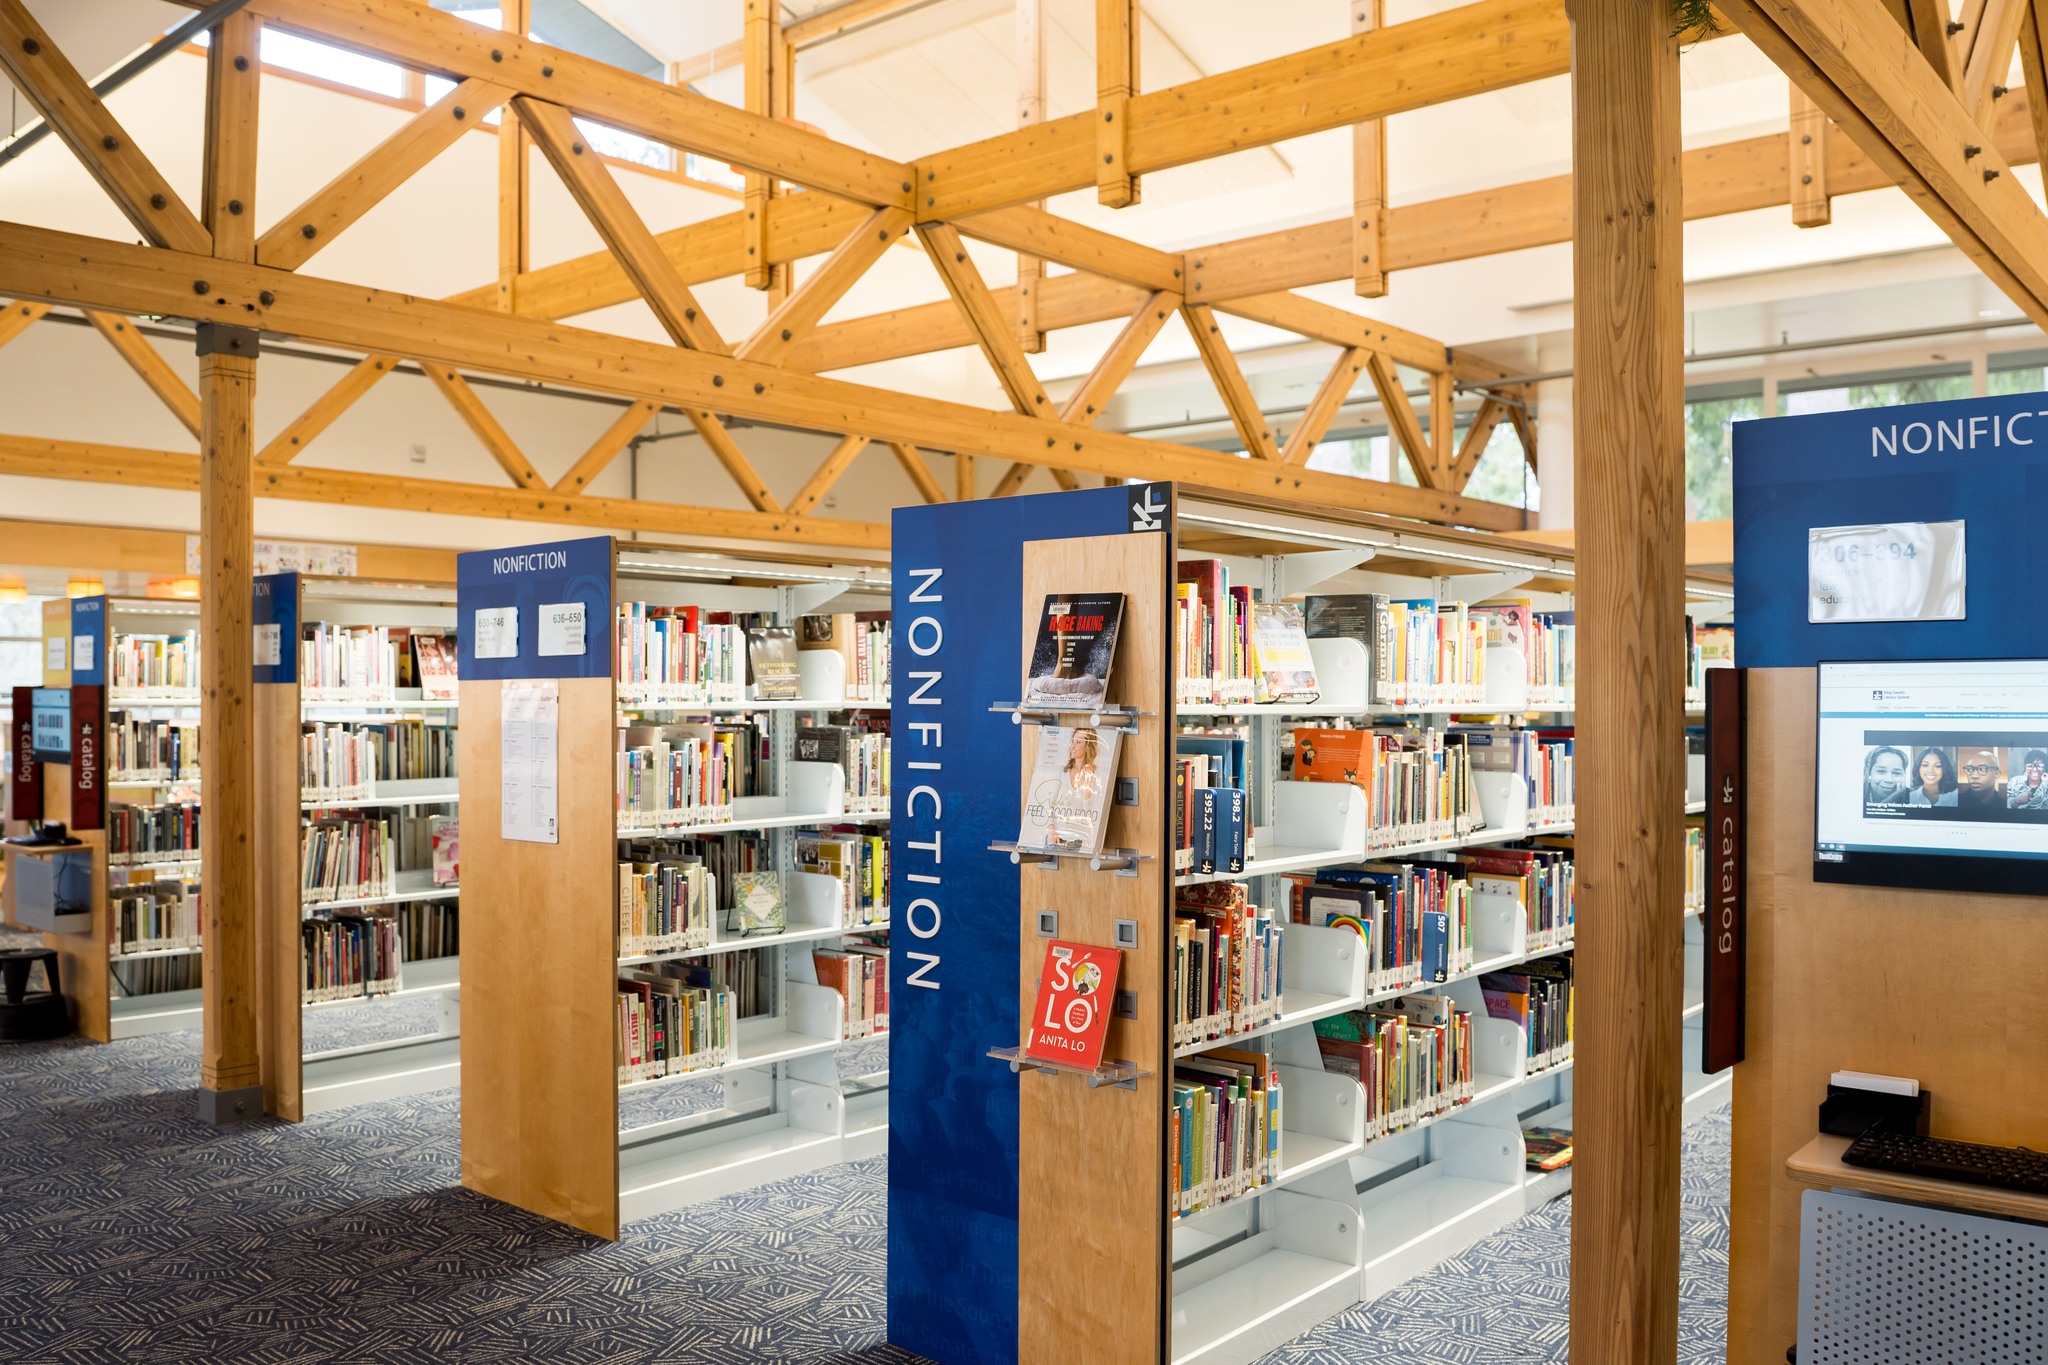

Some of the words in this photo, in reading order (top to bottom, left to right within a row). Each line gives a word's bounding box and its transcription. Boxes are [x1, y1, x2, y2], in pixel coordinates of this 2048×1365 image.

[493, 550, 567, 575] NONFICTION
[1048, 615, 1077, 632] RAGE
[1076, 615, 1105, 632] BAKING
[1380, 611, 1388, 680] German
[18, 734, 33, 782] catalog
[79, 737, 96, 790] catalog
[906, 567, 943, 991] NONFICTION
[1026, 804, 1045, 818] FEEL
[1204, 792, 1213, 831] 395.22
[1232, 791, 1241, 823] 398.2
[1718, 816, 1736, 954] catalog
[621, 886, 630, 934] CHEESE
[1437, 915, 1446, 933] 507
[631, 1013, 639, 1041] BUST
[1039, 1034, 1069, 1049] ANITA
[1070, 1039, 1086, 1052] LO
